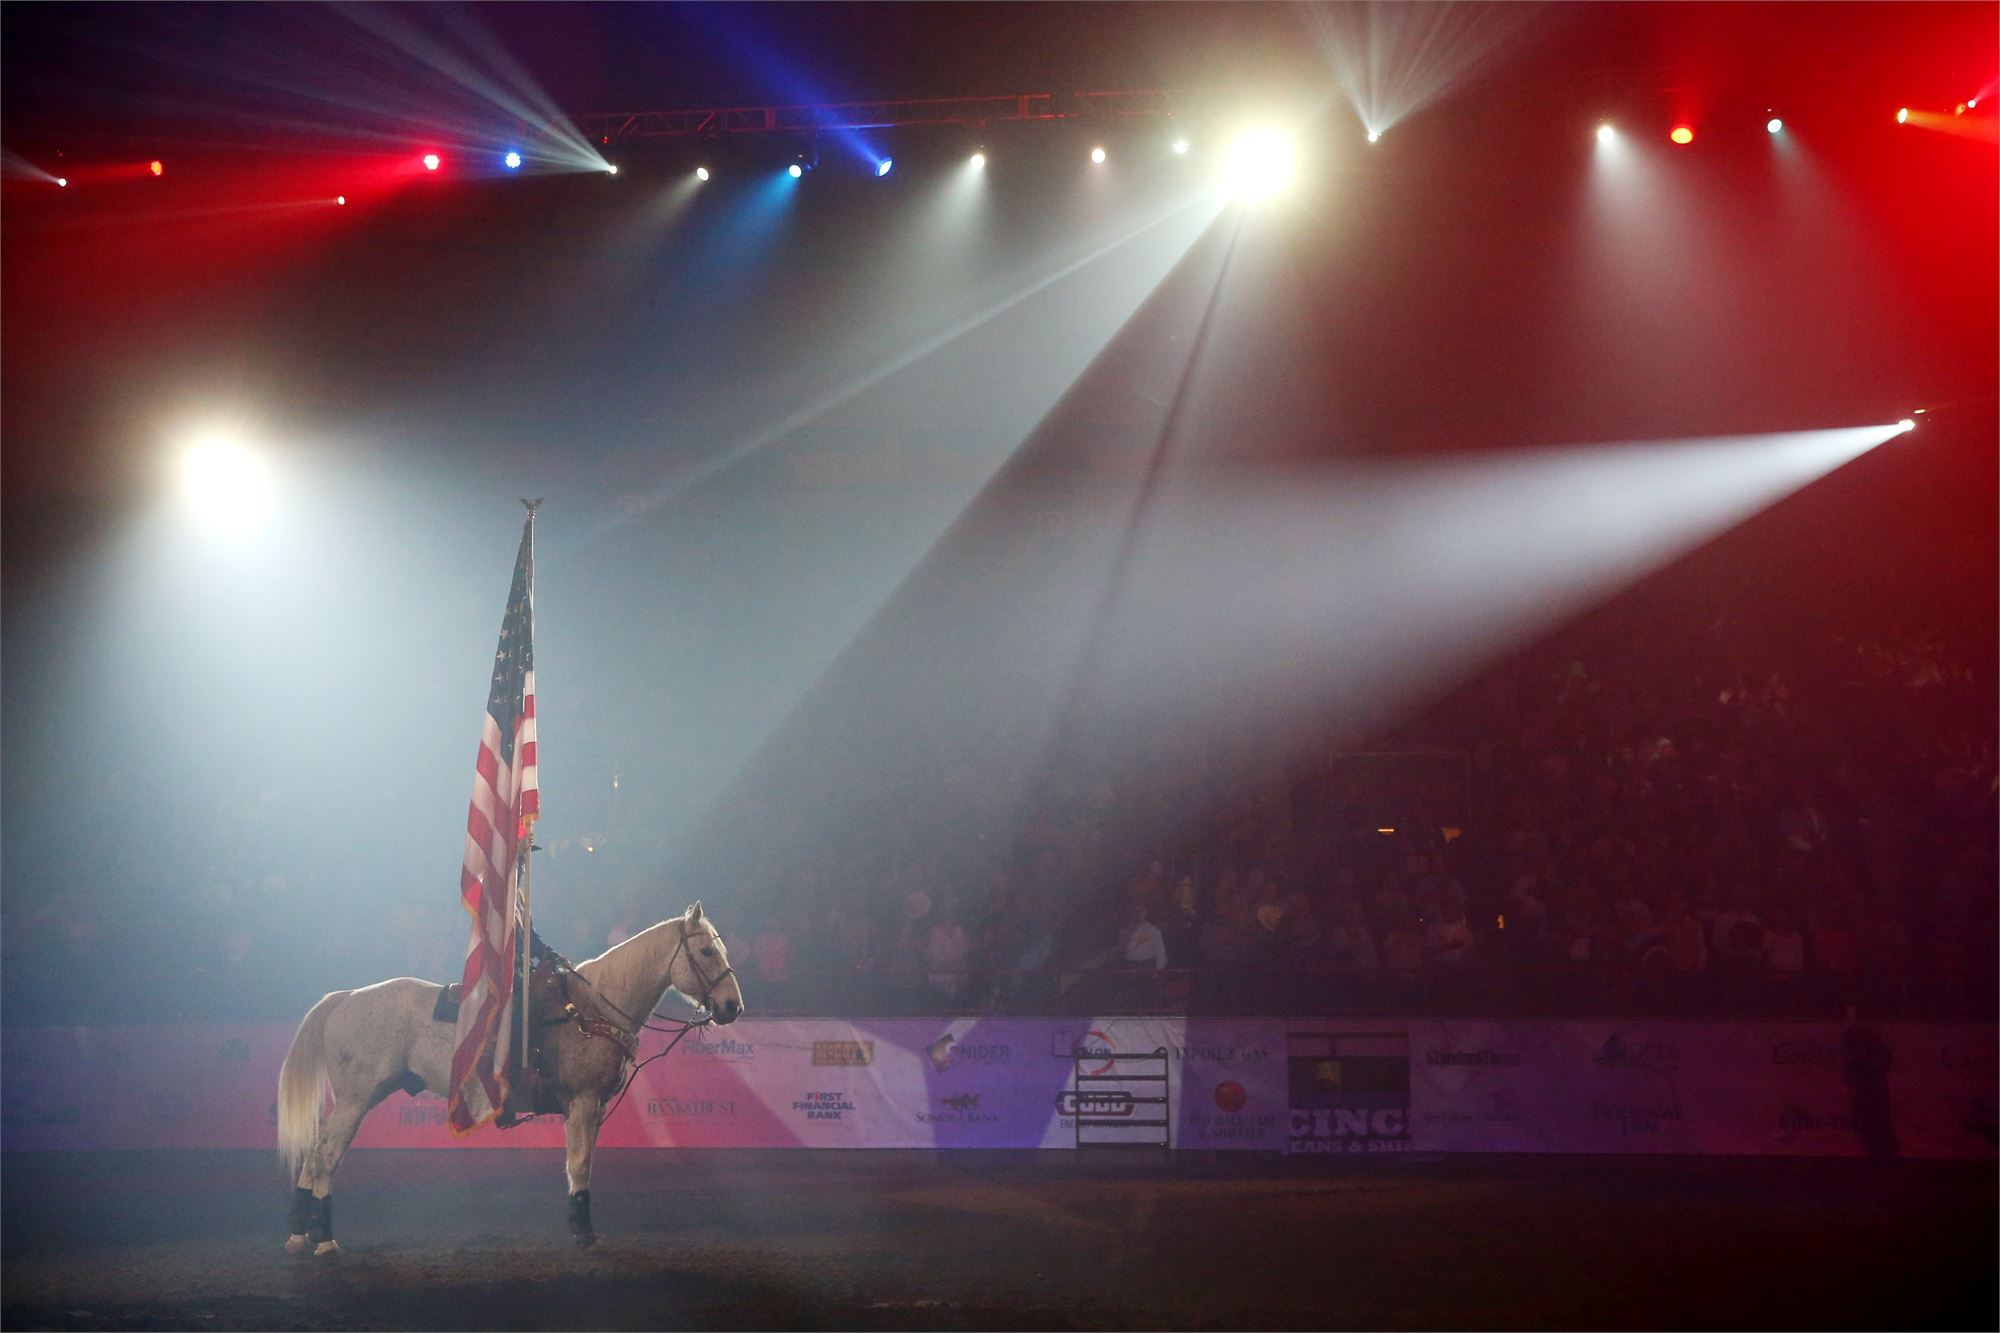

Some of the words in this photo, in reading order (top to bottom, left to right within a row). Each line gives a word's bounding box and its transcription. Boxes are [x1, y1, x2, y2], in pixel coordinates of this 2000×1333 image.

[683, 1040, 754, 1055] FiberMax
[807, 1091, 843, 1101] FIRST
[793, 1101, 856, 1111] FINANCIAL
[807, 1111, 841, 1120] BANK
[1288, 1109, 1408, 1136] CINC
